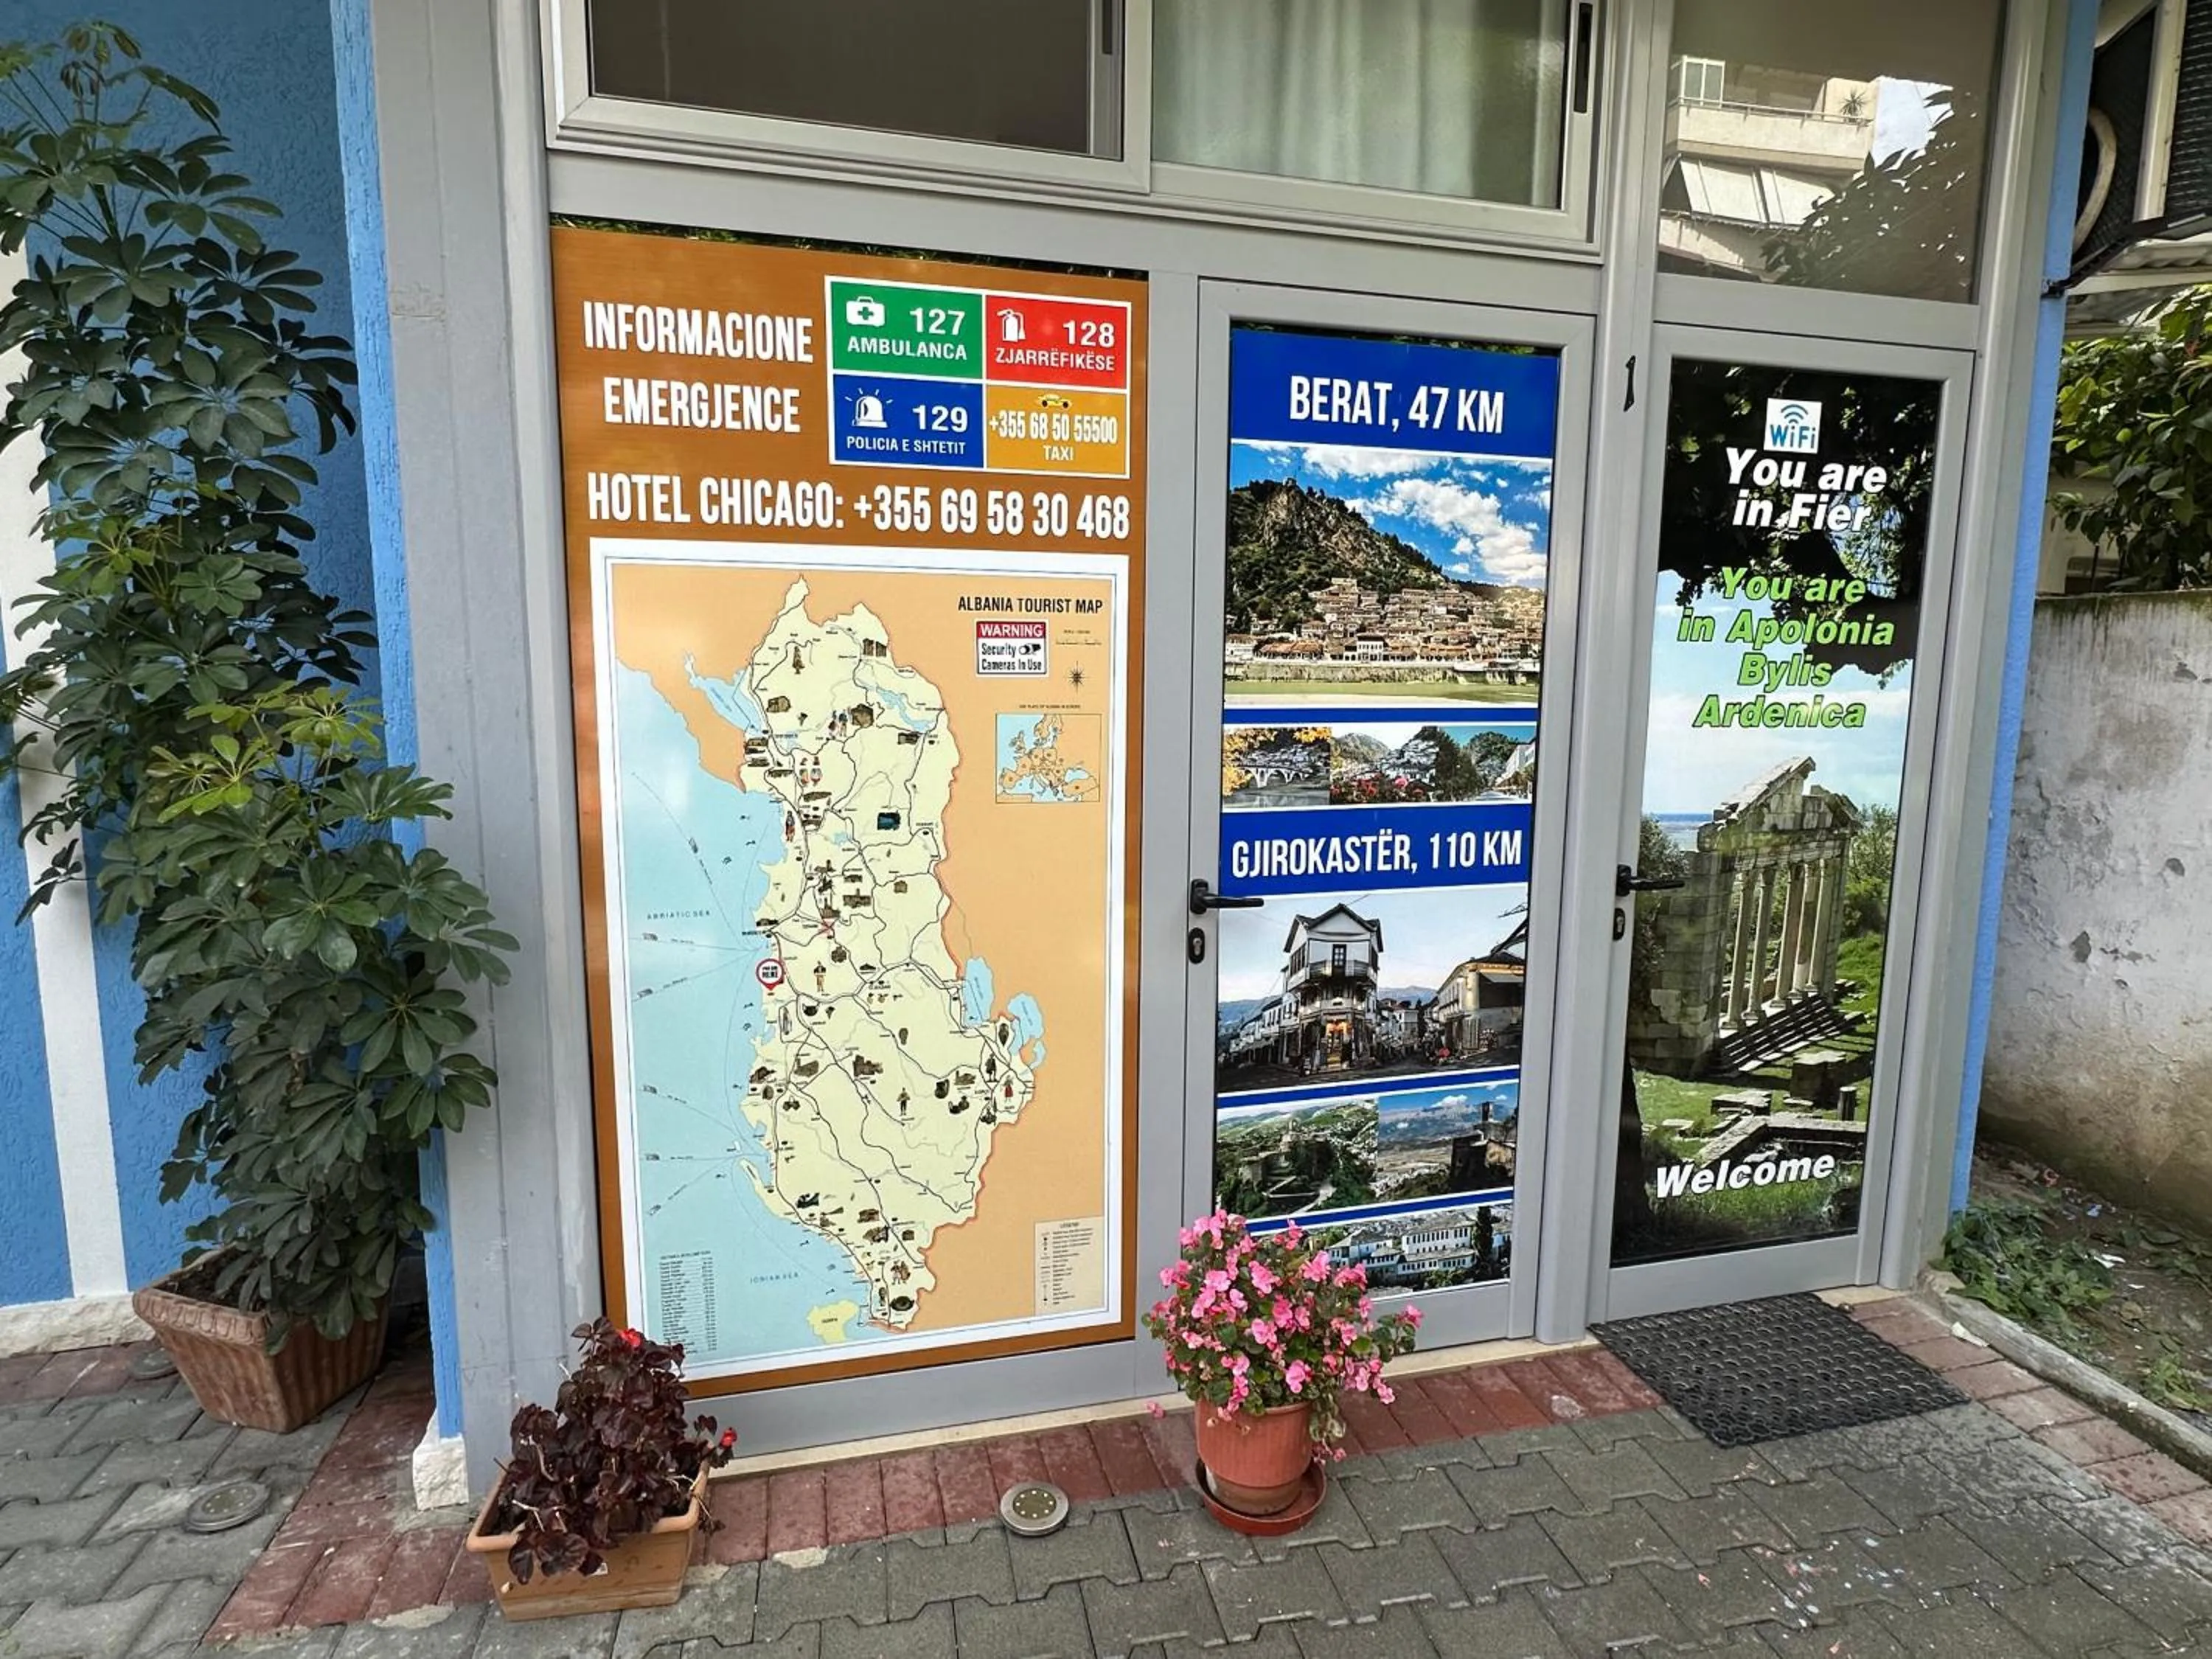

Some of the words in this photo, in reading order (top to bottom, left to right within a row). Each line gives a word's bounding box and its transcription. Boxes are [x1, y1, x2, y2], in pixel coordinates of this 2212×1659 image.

[583, 300, 814, 364] INFORMACIONE
[909, 307, 966, 337] 127
[1062, 320, 1116, 348] 128
[846, 335, 967, 361] AMBULANCA
[995, 347, 1116, 372] ZJARRËFIKËSE
[603, 377, 801, 434] EMERGJENCE
[912, 405, 969, 434] 129
[1290, 375, 1400, 433] BERAT,
[1408, 385, 1450, 430] 47
[1456, 389, 1506, 434] KM
[989, 409, 1026, 439] +355
[1030, 413, 1048, 442] 68
[1052, 414, 1069, 442] 50
[1073, 417, 1118, 445] 55500
[1770, 423, 1818, 451] WiFi
[846, 435, 898, 452] POLICIA
[902, 438, 909, 453] E
[914, 439, 967, 456] SHTETIT
[1043, 445, 1074, 462] TAXI
[1725, 447, 1805, 488] You
[1817, 462, 1888, 493] are
[588, 473, 690, 524] HOTEL
[699, 477, 845, 529] CHICAGO:
[853, 485, 933, 532] +355
[940, 488, 978, 534] 69
[987, 490, 1026, 536] 58
[1032, 493, 1069, 538] 30
[1076, 495, 1131, 540] 468
[1731, 489, 1774, 528] in
[1788, 493, 1873, 532] Fier
[1720, 567, 1793, 601] You
[1804, 576, 1868, 604] are
[958, 597, 1014, 613] ALBANIA
[1018, 598, 1072, 613] TOURIST
[1075, 599, 1104, 614] MAP
[979, 623, 1044, 638] WARNING
[1676, 606, 1716, 642] in
[1725, 608, 1896, 650] Apolonia
[981, 642, 1017, 658] Security
[981, 658, 1015, 671] Cameras
[1027, 658, 1042, 670] Use
[1736, 653, 1832, 693] Bylis
[1692, 694, 1867, 728] Ardenica
[1232, 828, 1419, 879] GJIROKASTËR,
[1429, 831, 1476, 869] 110
[1483, 830, 1523, 866] KM
[1657, 1154, 1836, 1198] Welcome
